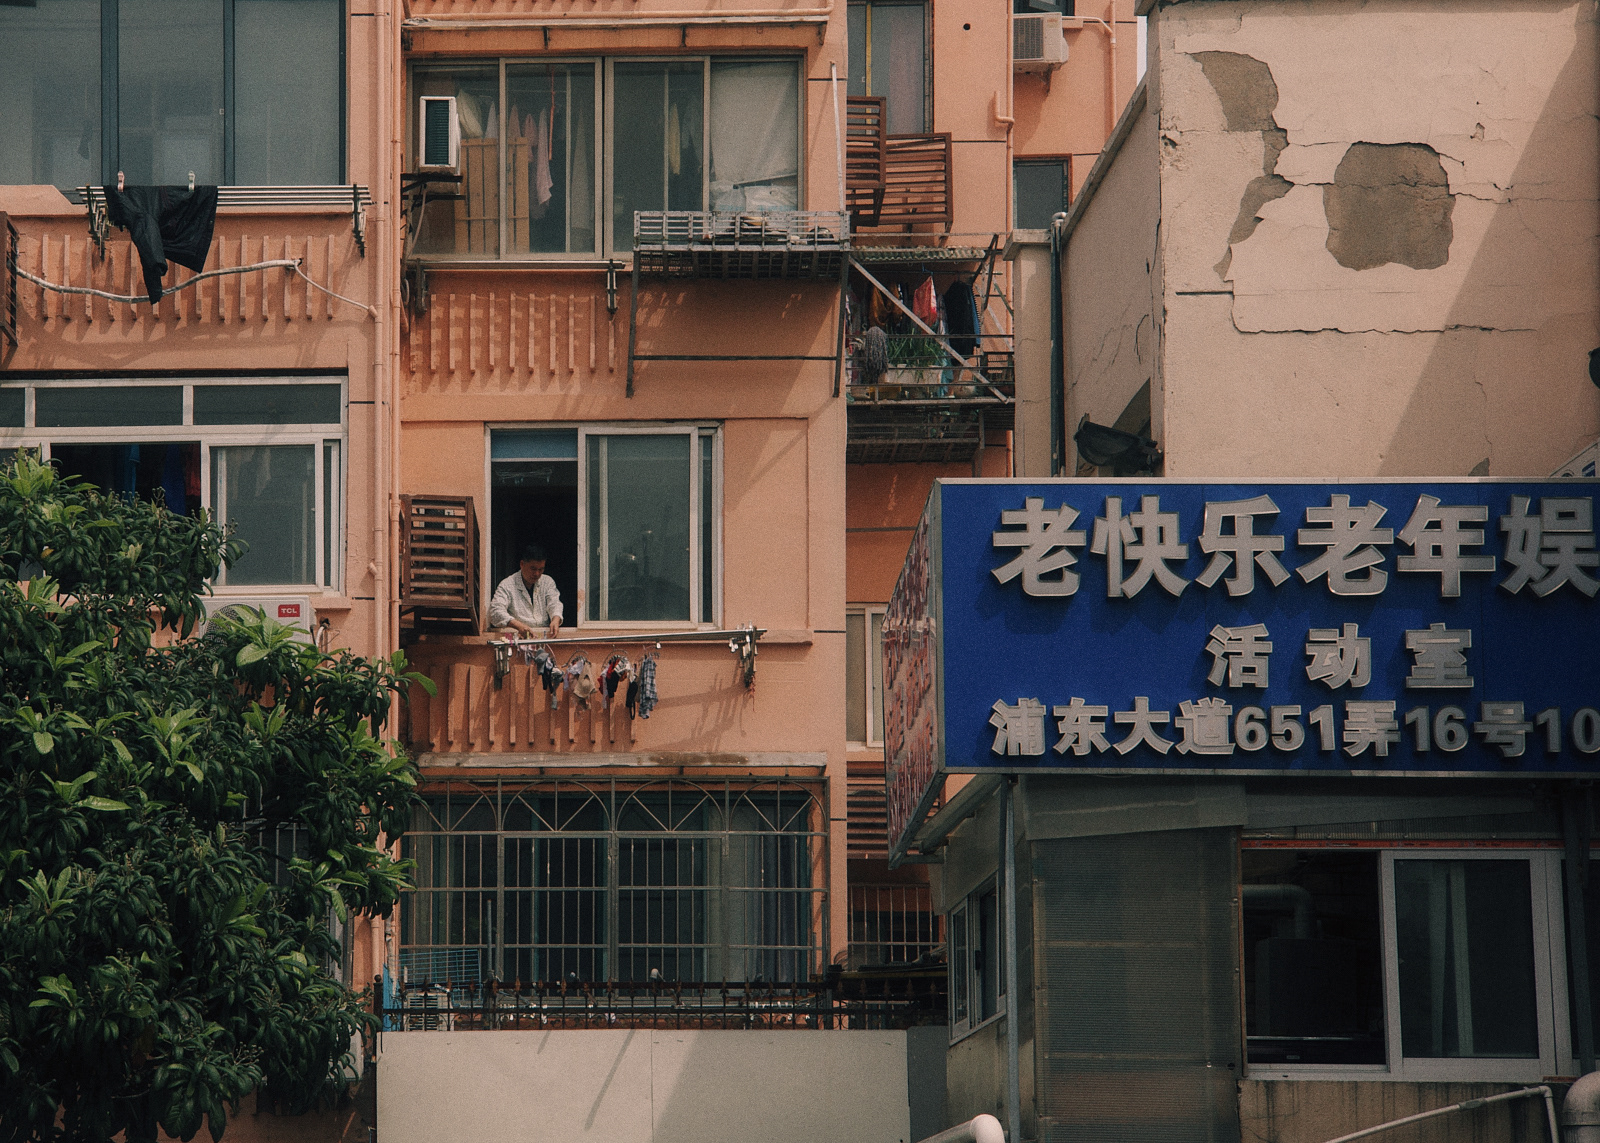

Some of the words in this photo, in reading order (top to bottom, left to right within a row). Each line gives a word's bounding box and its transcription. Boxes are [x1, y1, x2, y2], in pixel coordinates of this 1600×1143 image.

[991, 494, 1600, 599] 老快乐老年娱
[1206, 622, 1475, 689] 活动室
